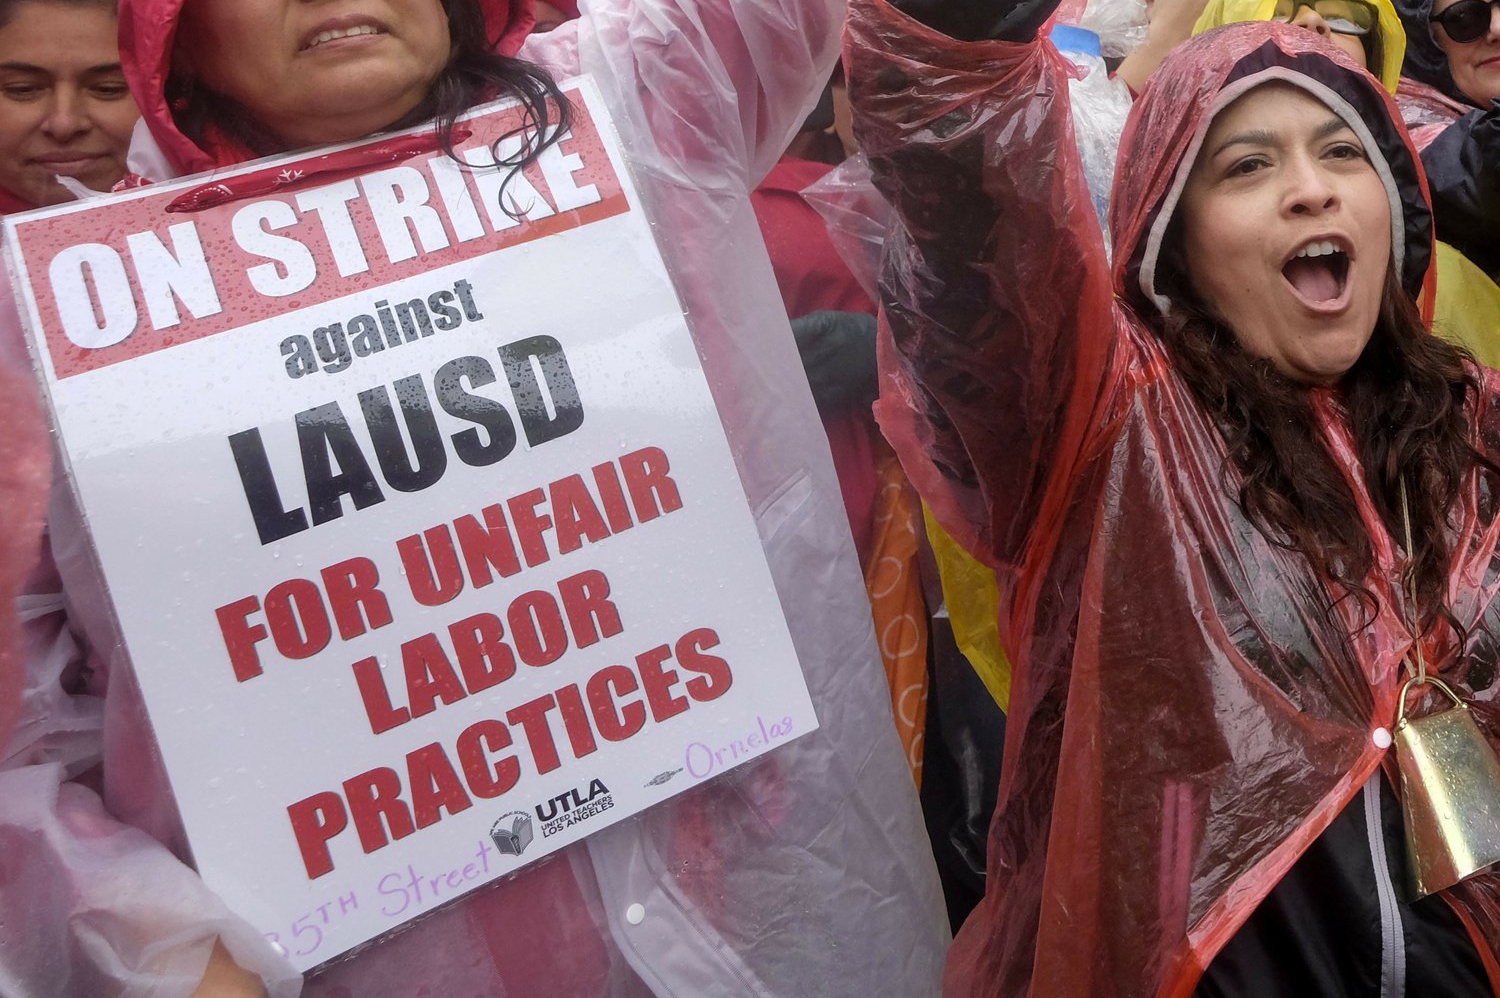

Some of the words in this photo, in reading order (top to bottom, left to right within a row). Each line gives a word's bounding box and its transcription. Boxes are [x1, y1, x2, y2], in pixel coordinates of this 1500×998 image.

[47, 222, 222, 352] ON
[239, 128, 603, 298] STRIKE
[279, 278, 485, 379] against
[228, 334, 588, 546] LAUSD
[215, 555, 396, 683] FOR
[397, 445, 684, 607] UNFAIR
[353, 569, 625, 736] LABOR
[286, 627, 735, 881] PRACTICES
[686, 716, 793, 779] Ornelas
[535, 778, 610, 822] UTLA
[540, 813, 571, 831] UNITED
[572, 794, 613, 817] TEACHERS
[542, 825, 564, 838] LOS
[566, 801, 615, 828] ANGELES
[377, 840, 492, 917] Street
